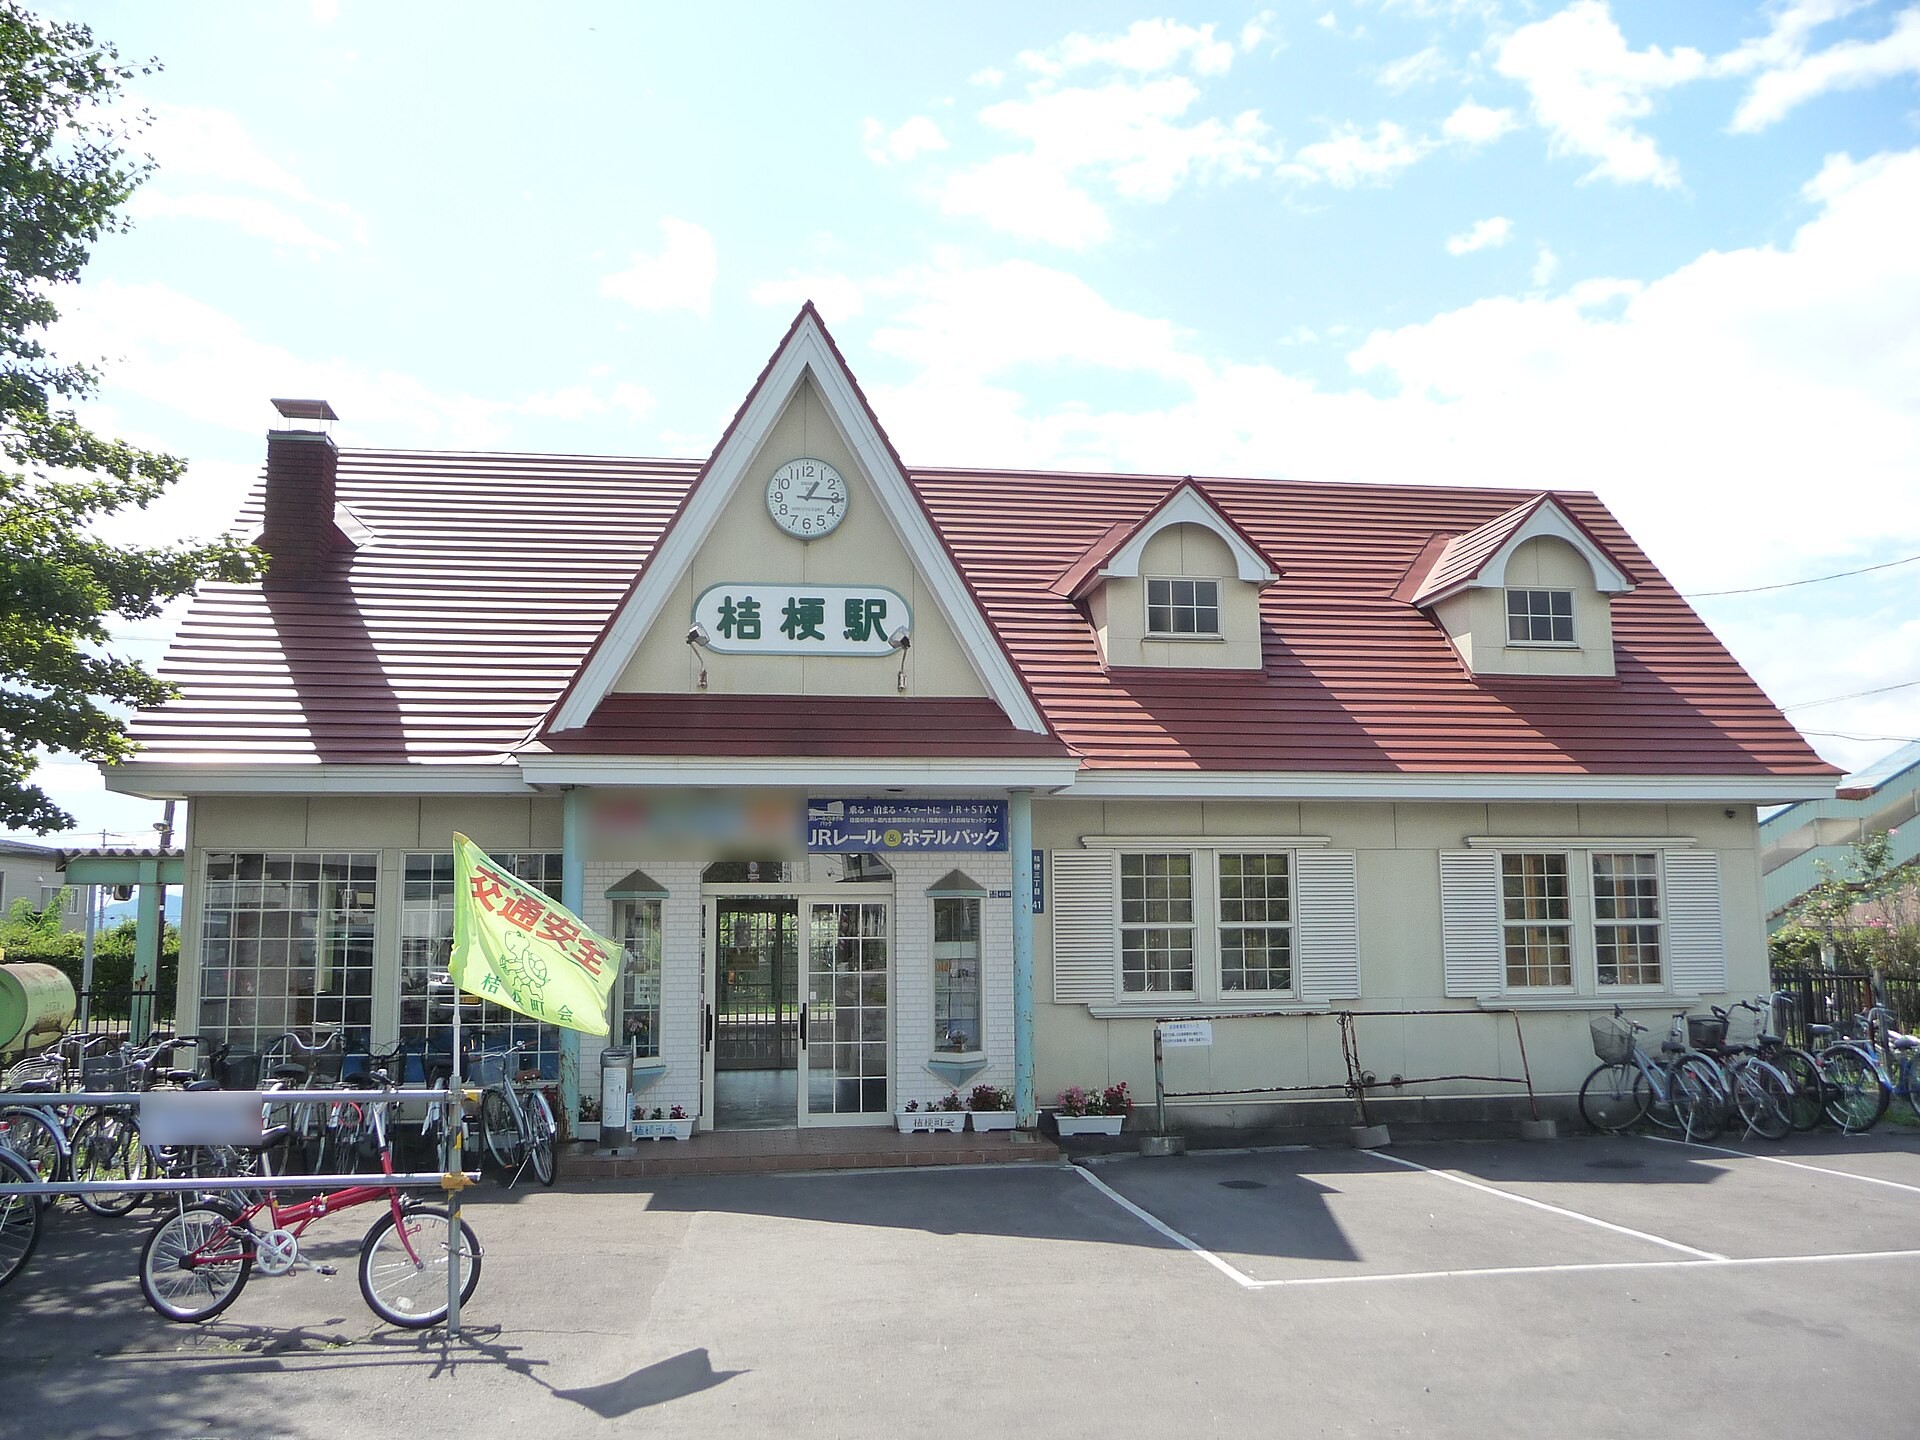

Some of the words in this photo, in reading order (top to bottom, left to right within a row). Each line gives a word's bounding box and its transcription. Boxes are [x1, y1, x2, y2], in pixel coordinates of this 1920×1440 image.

[790, 468, 799, 480] 11
[802, 465, 815, 478] 12
[778, 478, 790, 490] 10
[827, 478, 836, 490] 2
[774, 491, 783, 503] 9
[831, 492, 840, 504] 3
[779, 504, 788, 516] 8
[826, 505, 836, 517] 4
[789, 515, 799, 527] 7
[802, 517, 811, 530] 6
[816, 515, 825, 527] 5
[717, 595, 889, 642] 桔梗駅
[948, 805, 999, 814] JR+STAY
[808, 828, 1000, 848] JRレール&ホテルパック
[1033, 855, 1041, 895] 桔梗三丁目
[1032, 901, 1041, 909] 41
[469, 864, 610, 976] 交通安全
